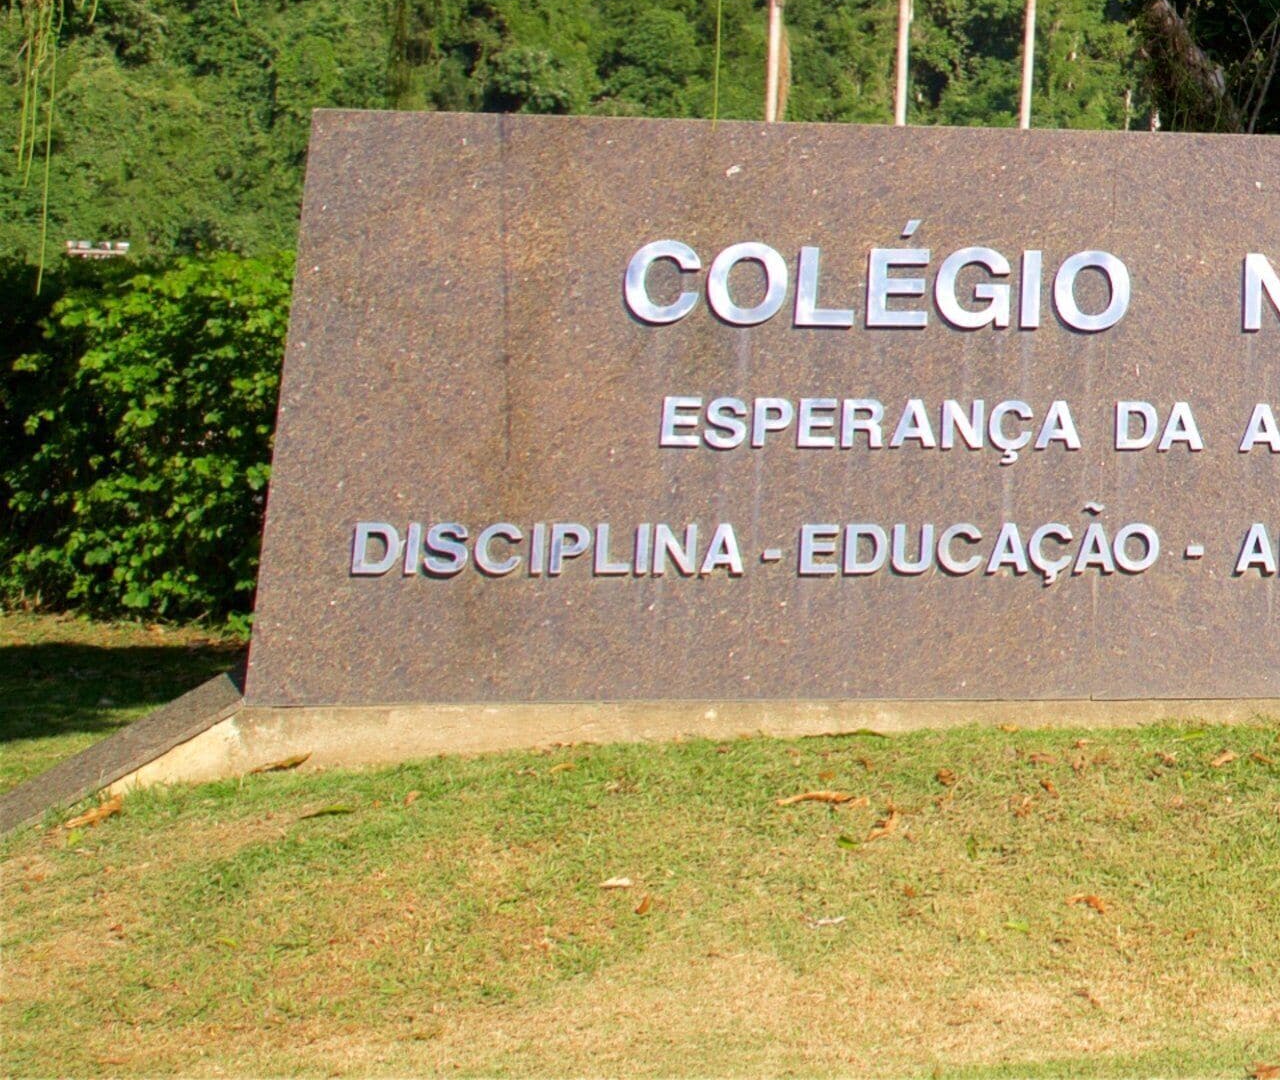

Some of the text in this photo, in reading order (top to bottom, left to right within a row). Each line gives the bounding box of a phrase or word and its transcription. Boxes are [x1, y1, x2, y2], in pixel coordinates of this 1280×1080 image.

[624, 220, 1131, 332] COLÉGIO
[659, 396, 1082, 465] ESPERANÇA
[1114, 401, 1204, 452] DA
[351, 522, 744, 576] DISCIPLINA
[799, 501, 1160, 585] EDUCAÇÃO
